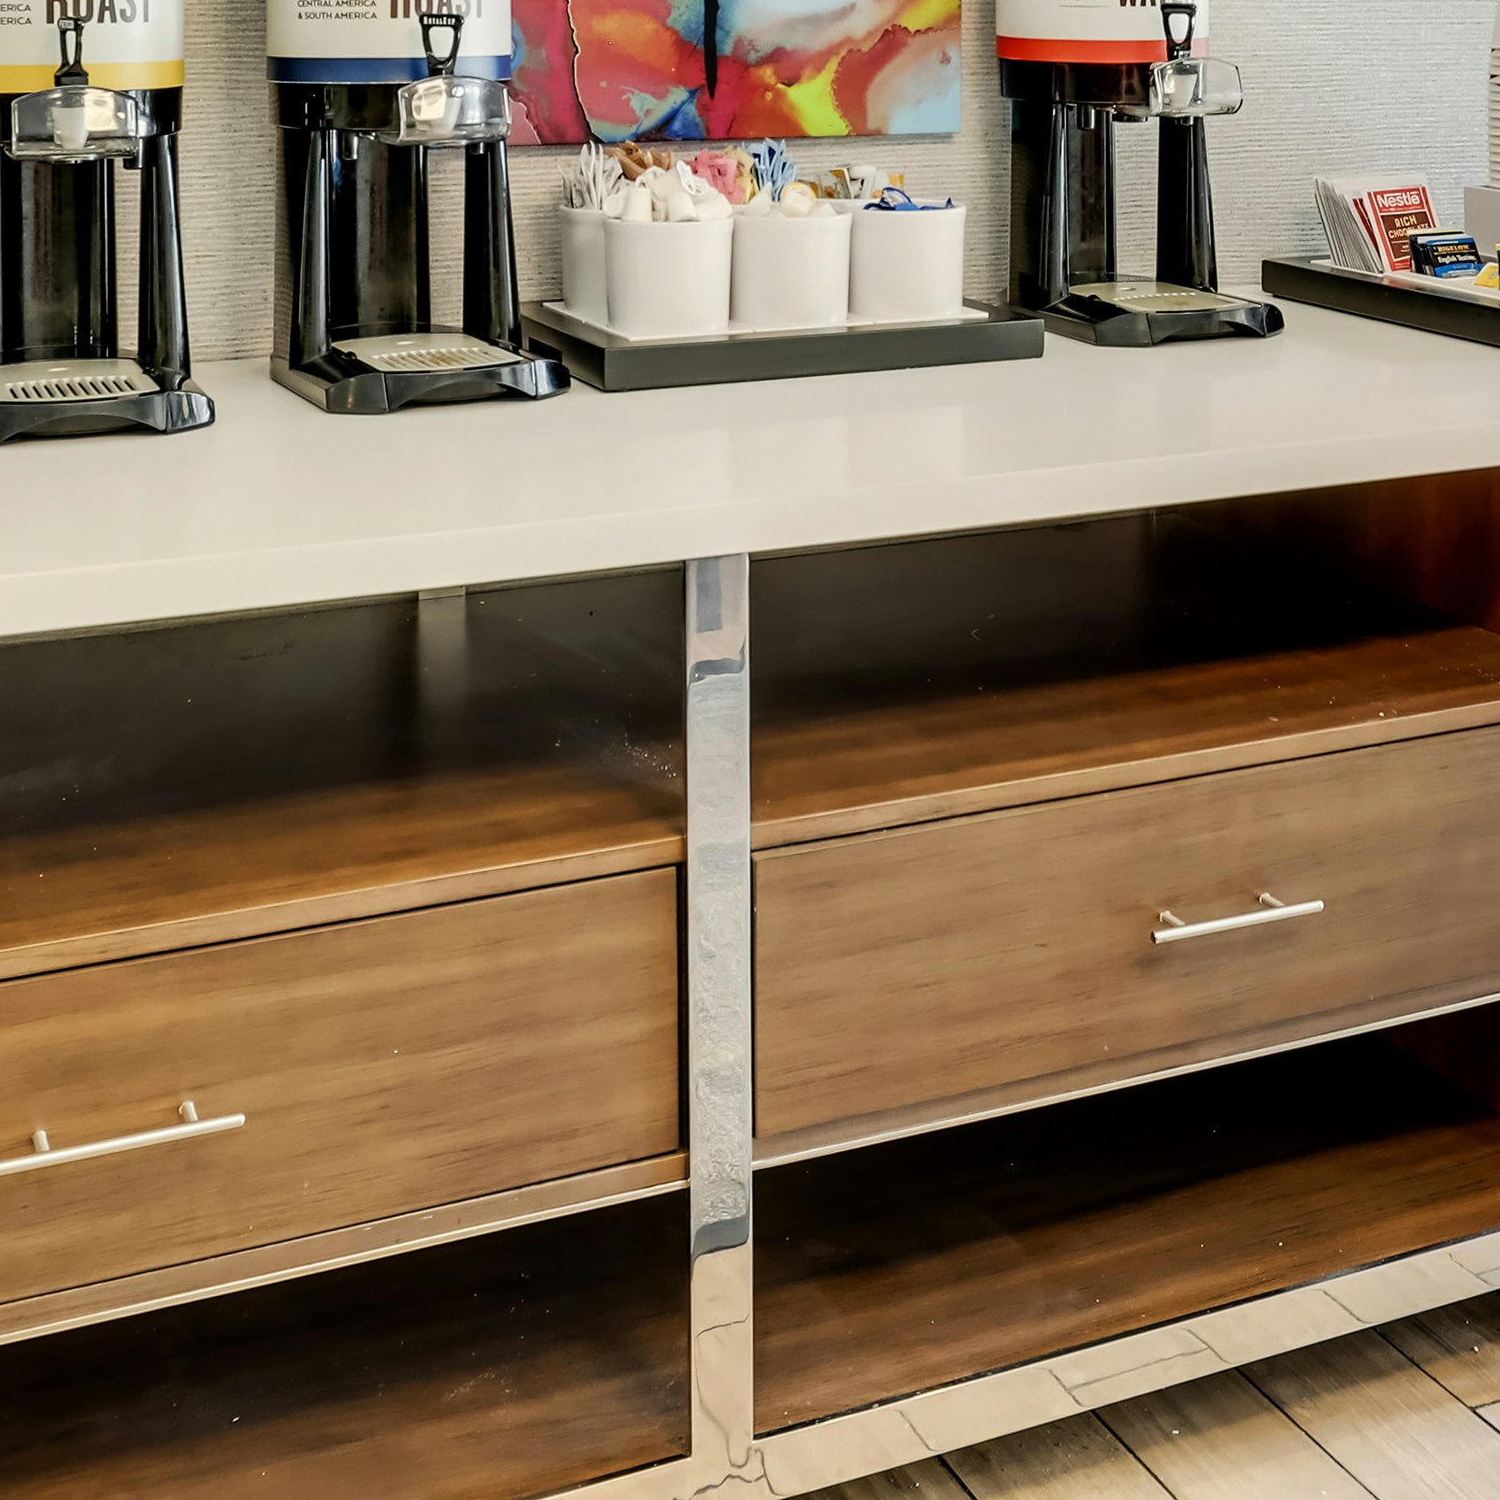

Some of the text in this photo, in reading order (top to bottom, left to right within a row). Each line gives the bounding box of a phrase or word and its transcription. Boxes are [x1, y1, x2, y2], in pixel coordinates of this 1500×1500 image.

[297, 0, 377, 8] CENTRAL AMERICA
[304, 11, 333, 20] SOUTH
[333, 11, 378, 20] AMERICA
[1394, 215, 1418, 228] RICH
